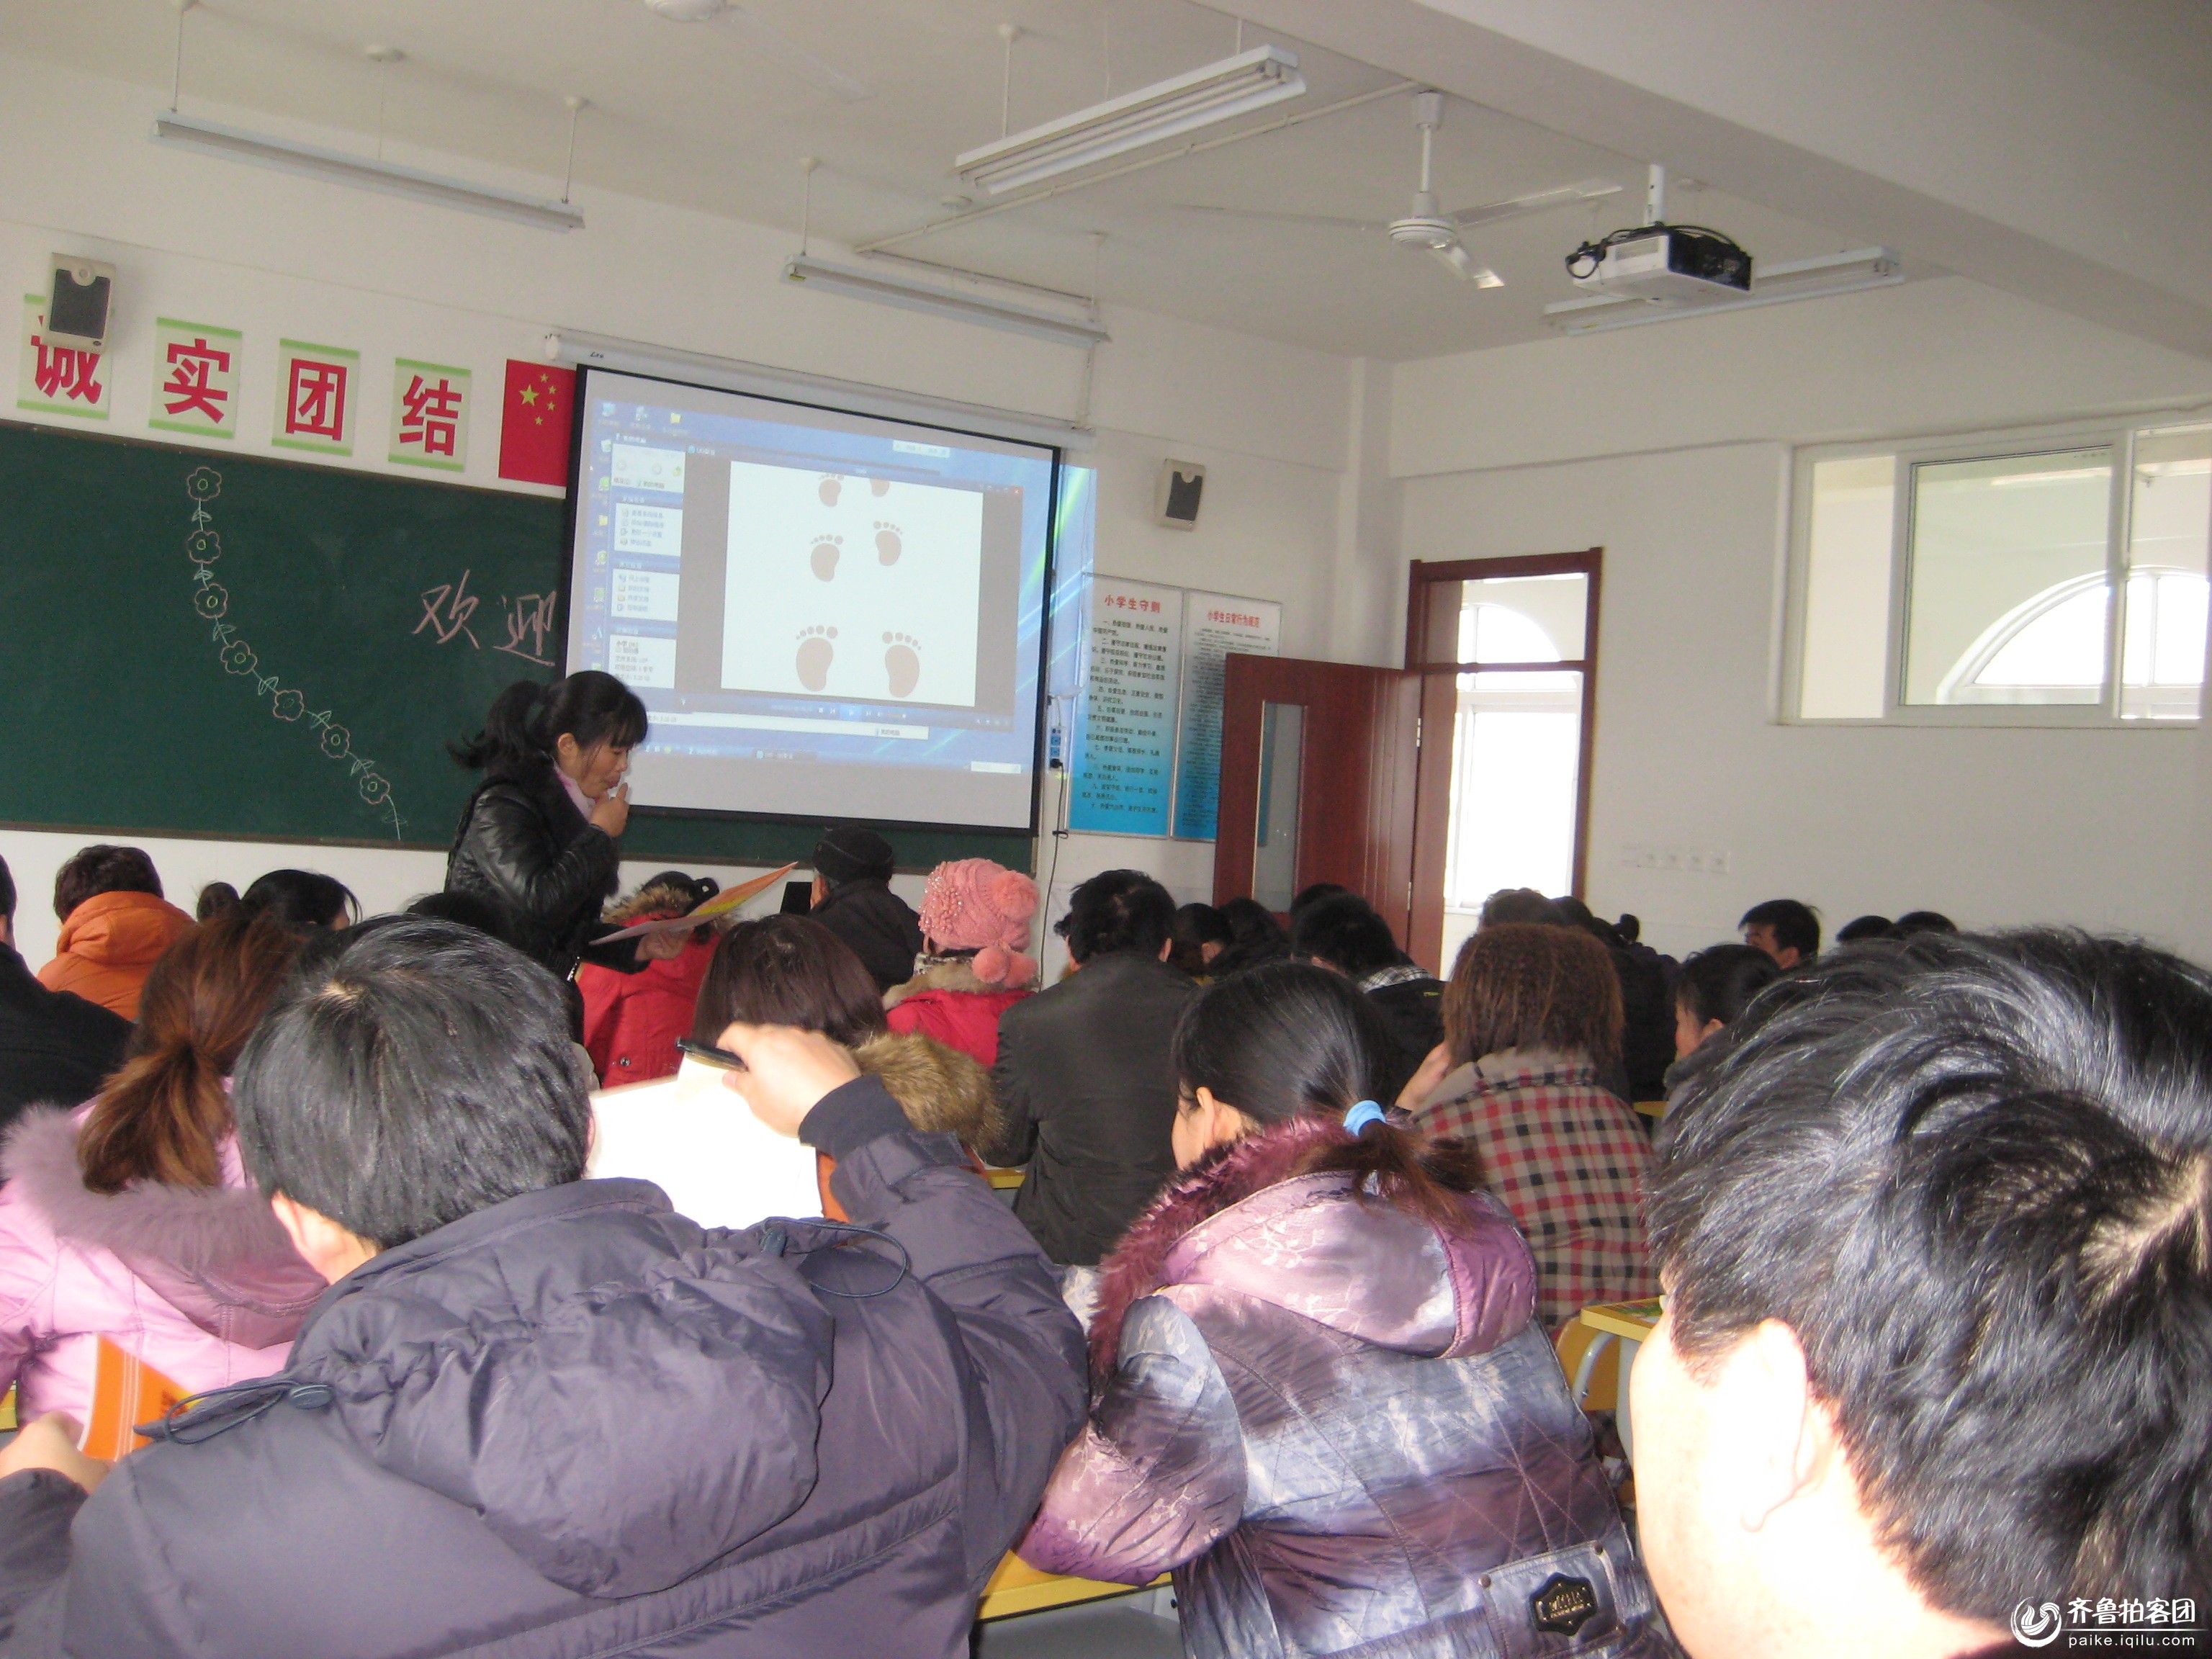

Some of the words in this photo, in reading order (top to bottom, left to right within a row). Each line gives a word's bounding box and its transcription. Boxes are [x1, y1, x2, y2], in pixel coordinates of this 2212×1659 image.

[411, 569, 557, 667] 欢迎
[1105, 595, 1161, 613] 小学生守则
